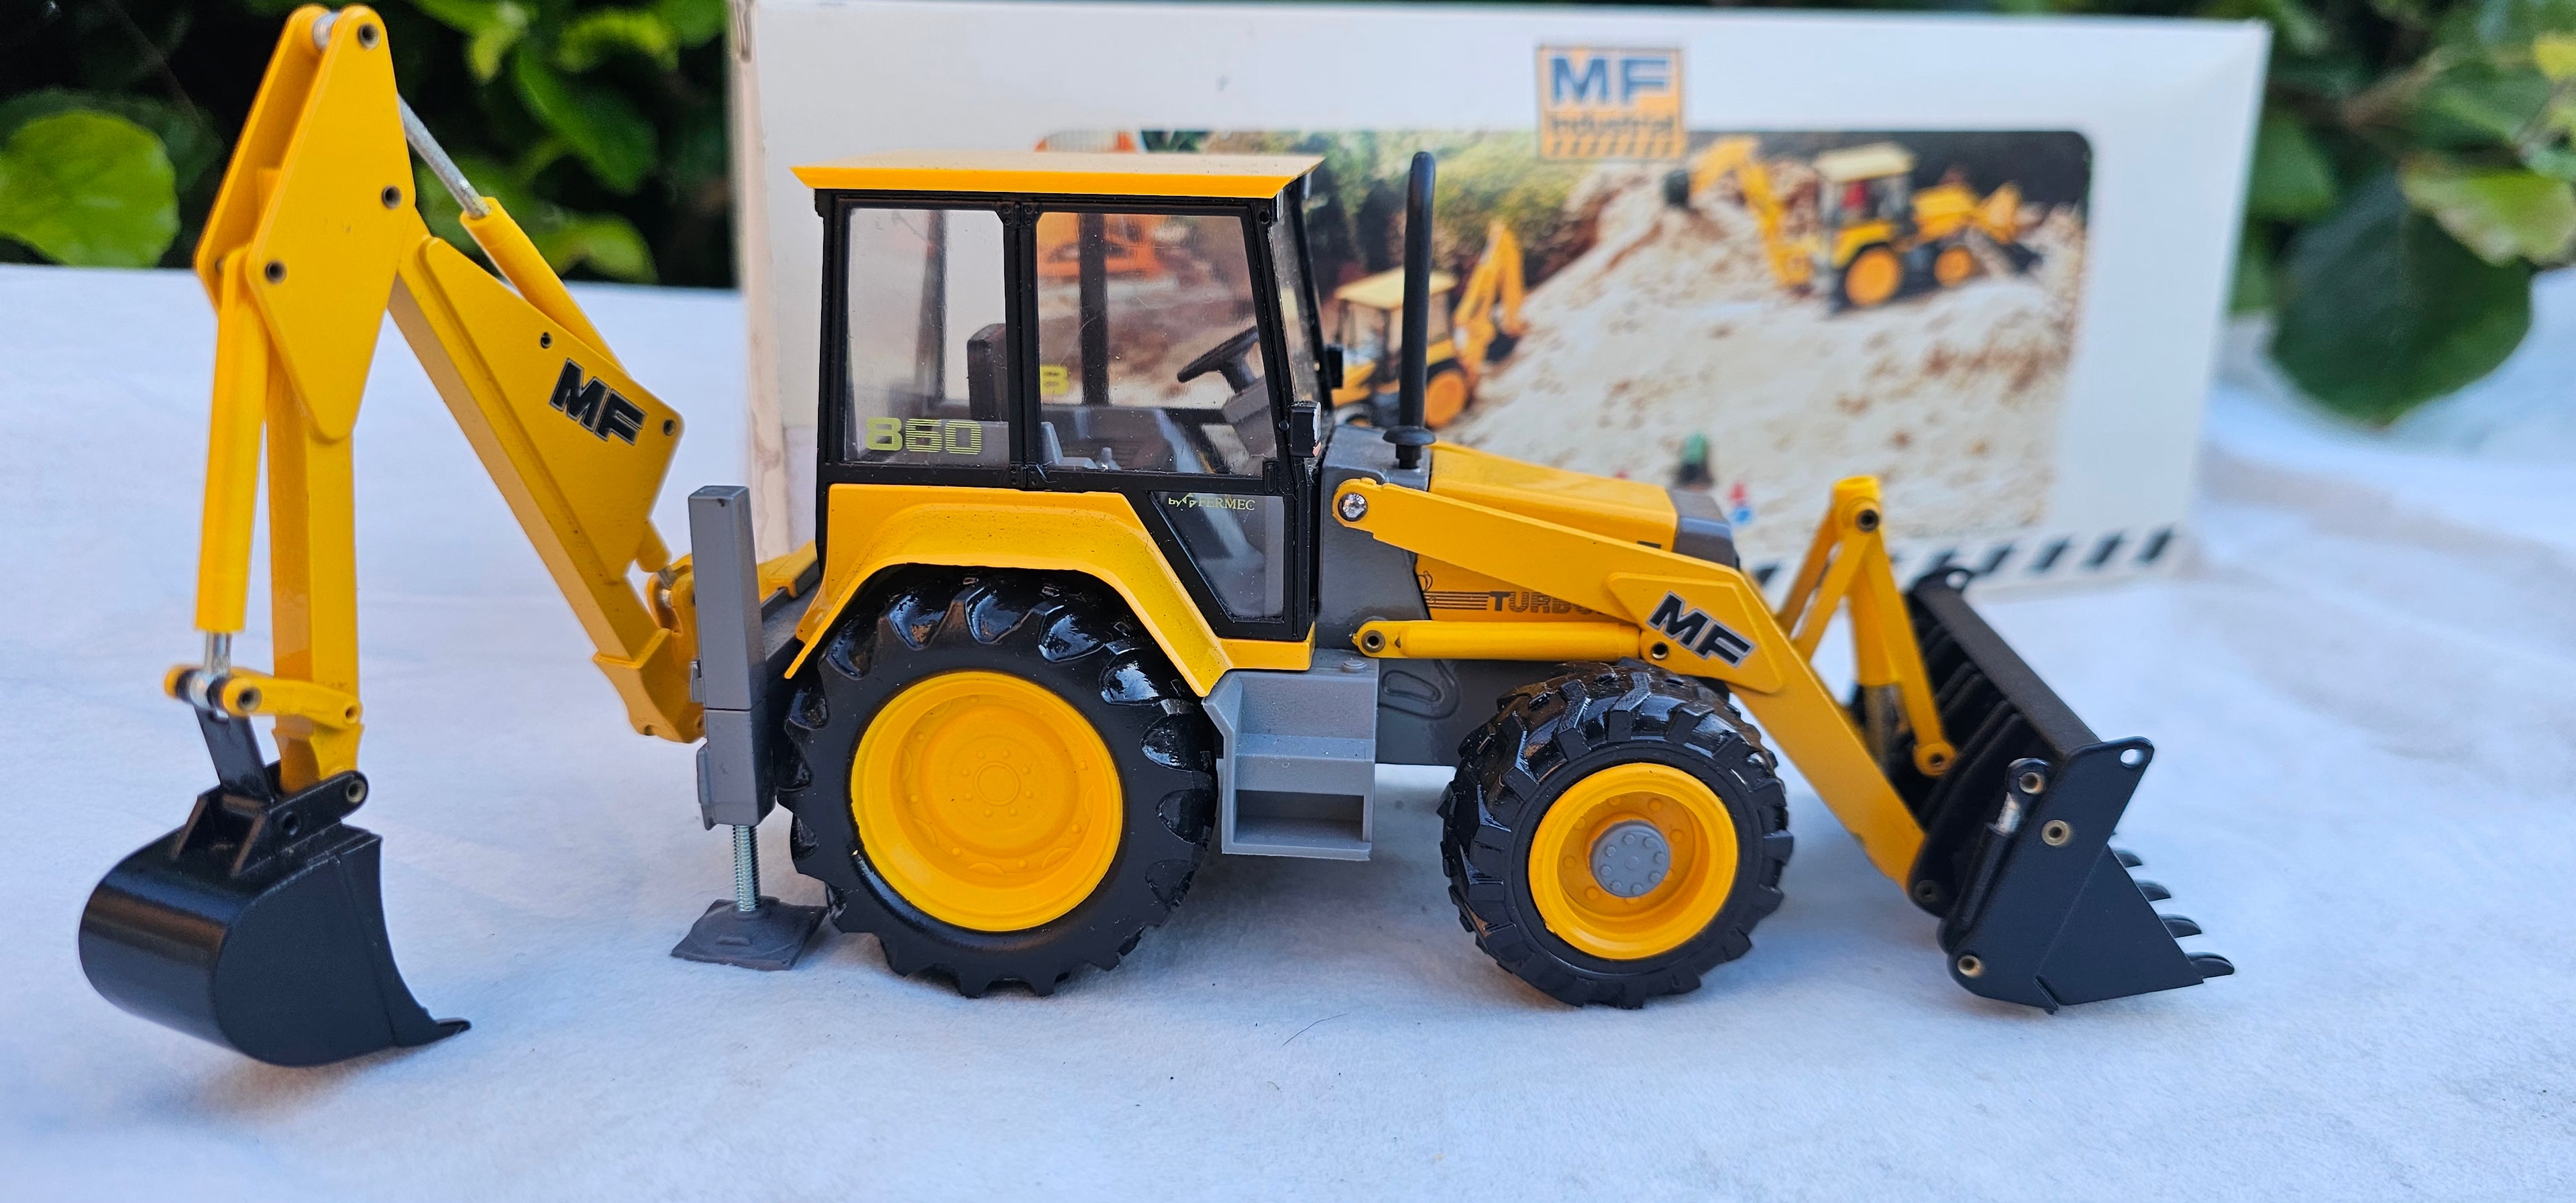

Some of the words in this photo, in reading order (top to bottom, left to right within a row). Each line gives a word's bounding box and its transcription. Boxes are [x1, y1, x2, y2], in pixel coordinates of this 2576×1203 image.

[1550, 56, 1669, 105] MF
[549, 357, 648, 446] MF
[1168, 497, 1182, 507] by
[1198, 497, 1255, 511] FERMEC
[1646, 590, 1755, 668] MF
